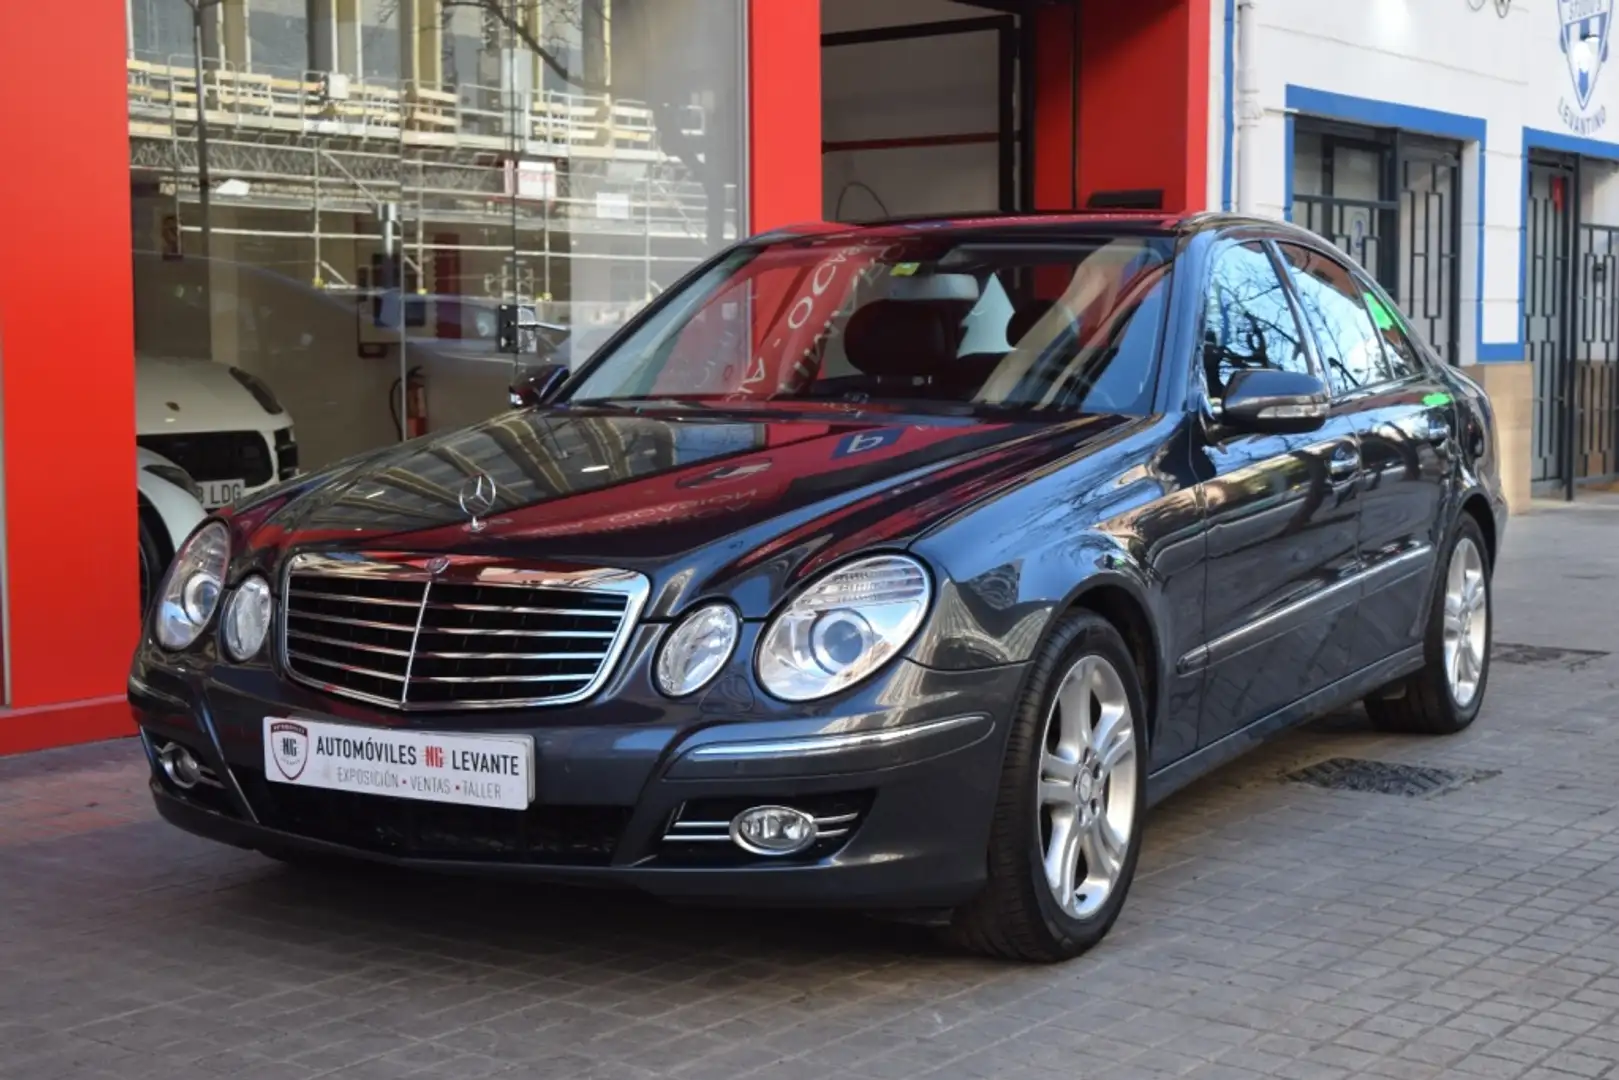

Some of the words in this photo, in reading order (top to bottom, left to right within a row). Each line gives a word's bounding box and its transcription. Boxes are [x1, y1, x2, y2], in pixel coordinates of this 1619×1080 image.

[1558, 96, 1606, 136] LEVANTINO
[316, 736, 417, 765] AUTOMÓVILES
[451, 749, 519, 776] LEVANTE
[337, 766, 399, 788] EXPOSICIÓN
[410, 776, 450, 794] VENTAS
[463, 780, 501, 799] TALLER
